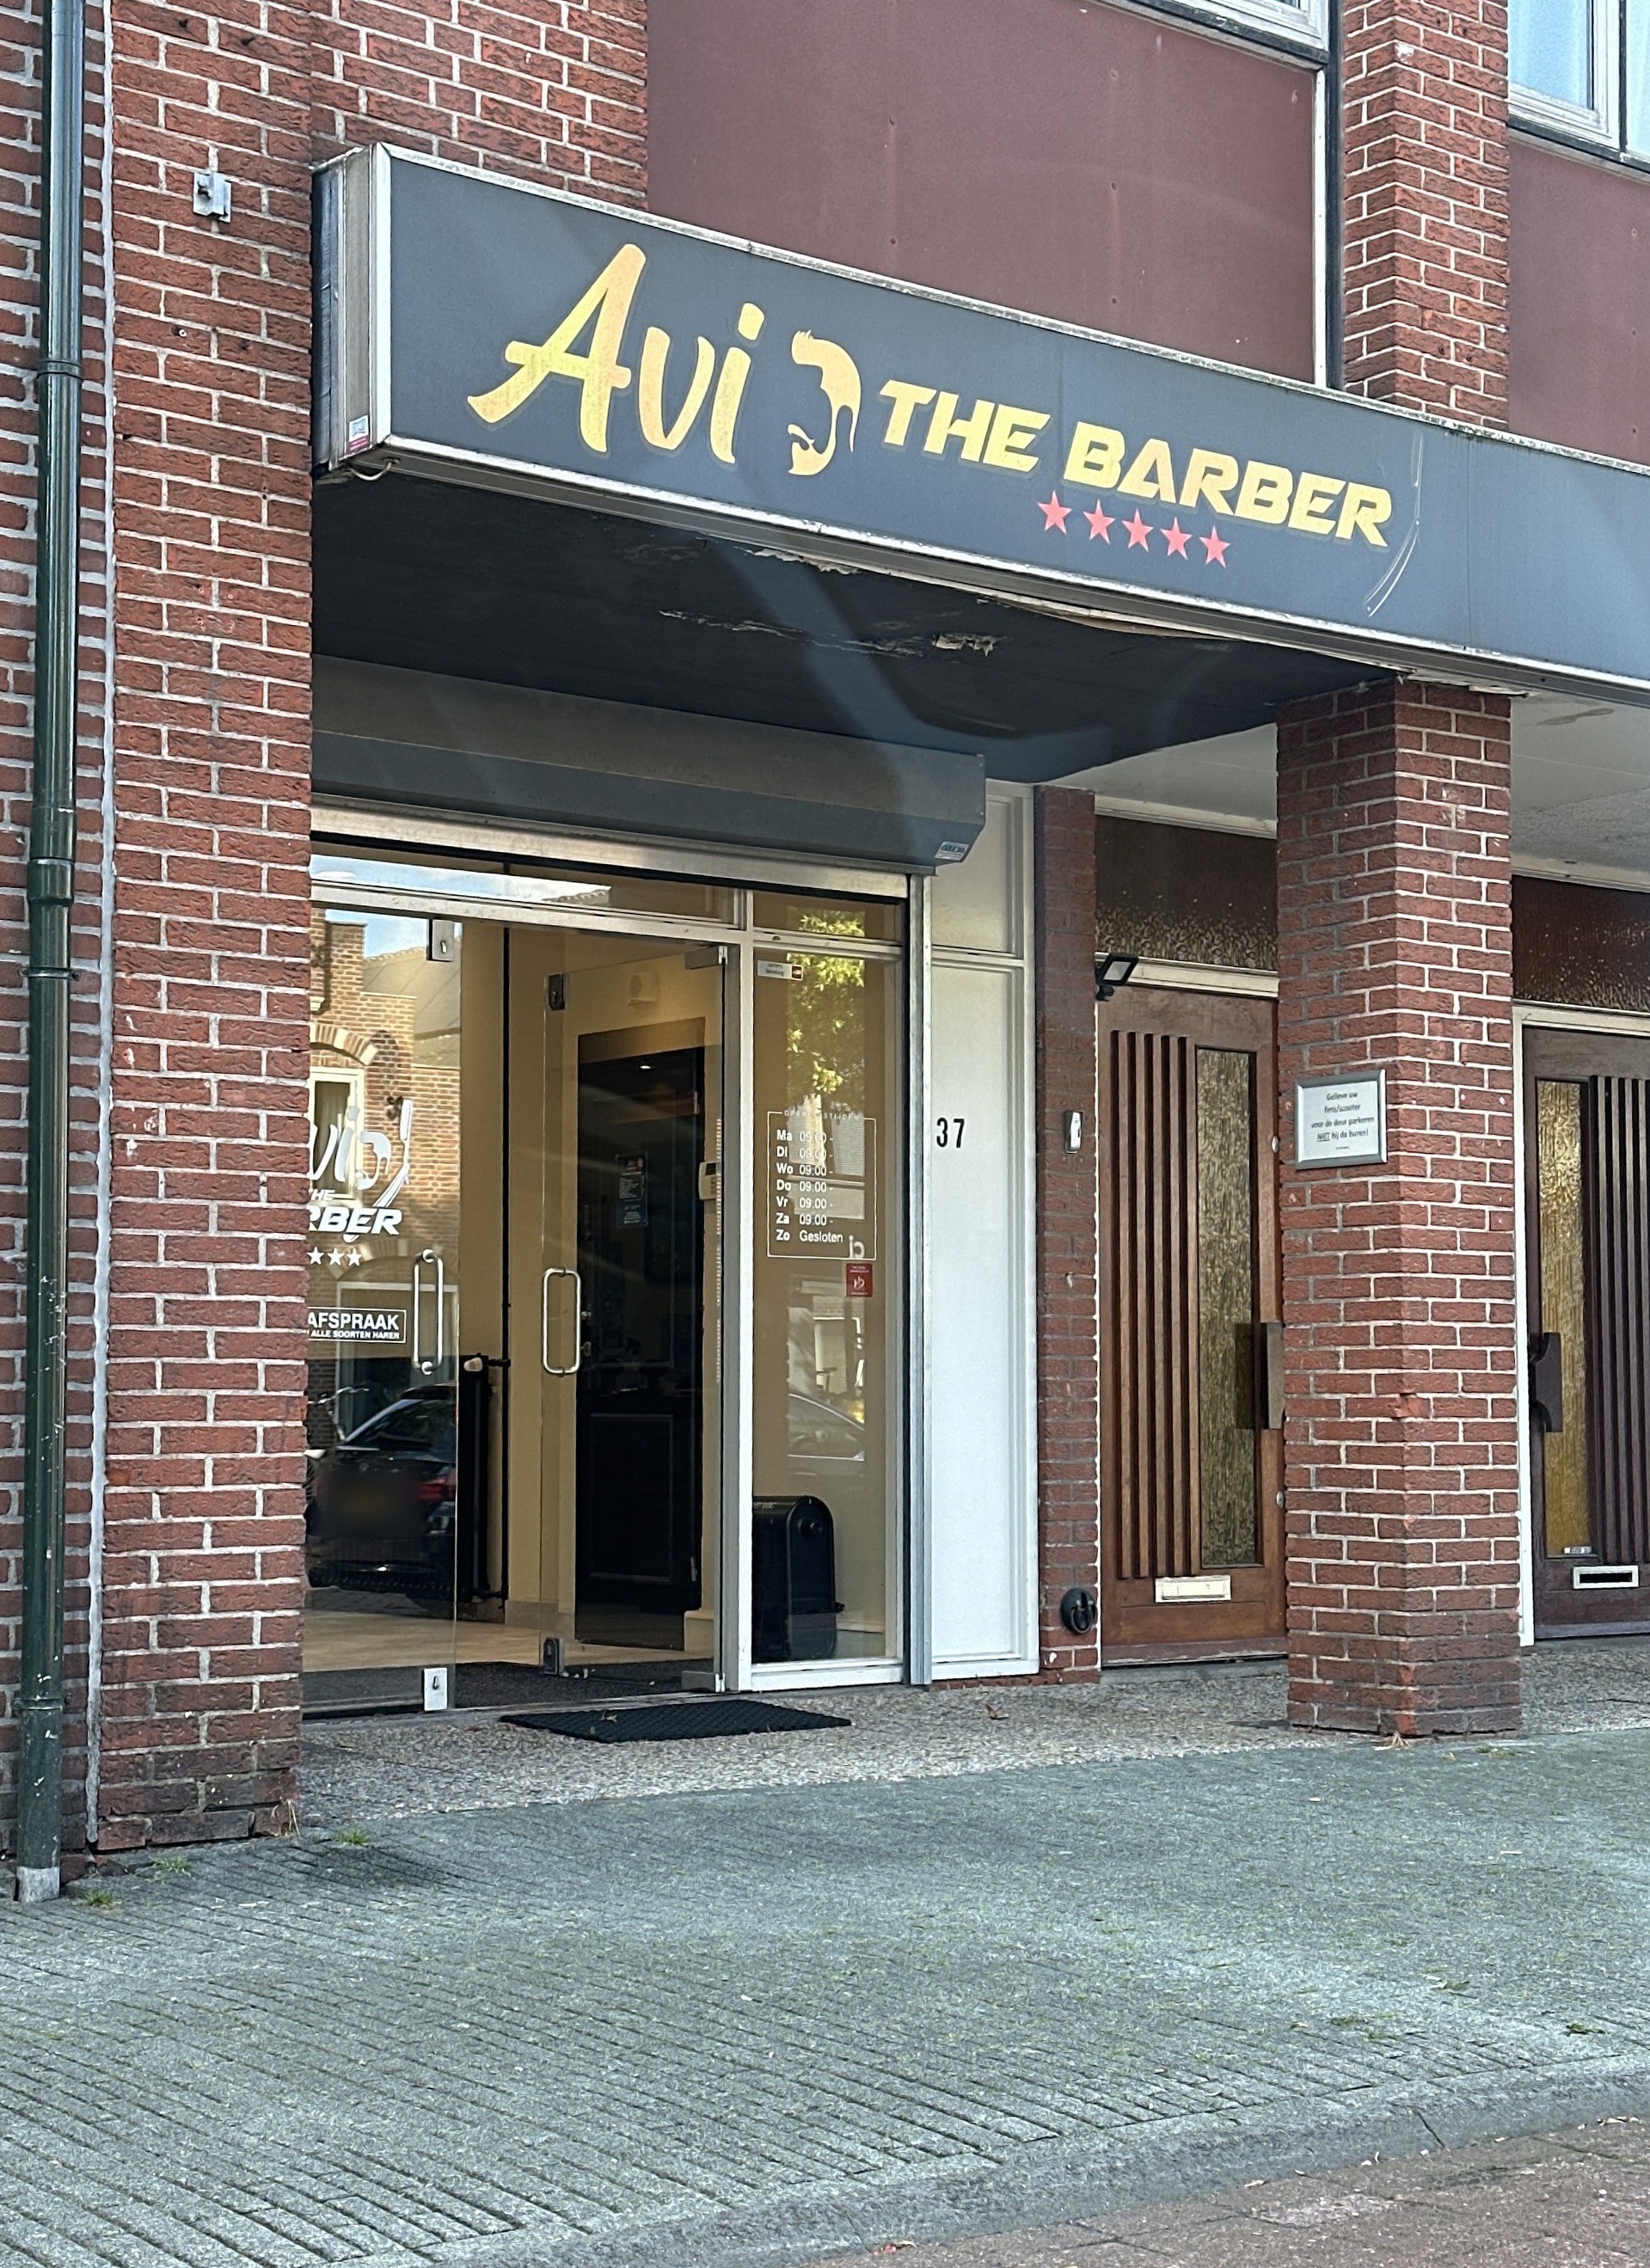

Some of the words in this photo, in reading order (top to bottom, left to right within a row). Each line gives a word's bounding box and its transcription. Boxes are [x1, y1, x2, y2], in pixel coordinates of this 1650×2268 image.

[466, 242, 765, 464] Avi
[879, 378, 1051, 473] THE
[1063, 420, 1393, 548] BARBER
[1325, 1119, 1333, 1128] de
[1348, 1117, 1375, 1126] parkeren
[776, 1129, 793, 1142] Ma
[935, 1117, 966, 1149] 37
[776, 1145, 789, 1158] Di
[776, 1162, 794, 1174] Wo
[776, 1179, 792, 1192] Do
[309, 1188, 335, 1201] HE
[776, 1195, 788, 1208] Vr
[776, 1212, 790, 1224] Za
[776, 1229, 791, 1241] Zo
[799, 1229, 843, 1243] Gesloten
[308, 1311, 400, 1331] AFSPRAAK
[310, 1329, 332, 1338] ALLE
[332, 1330, 371, 1339] SOORTEN
[371, 1331, 400, 1339] HAREN
